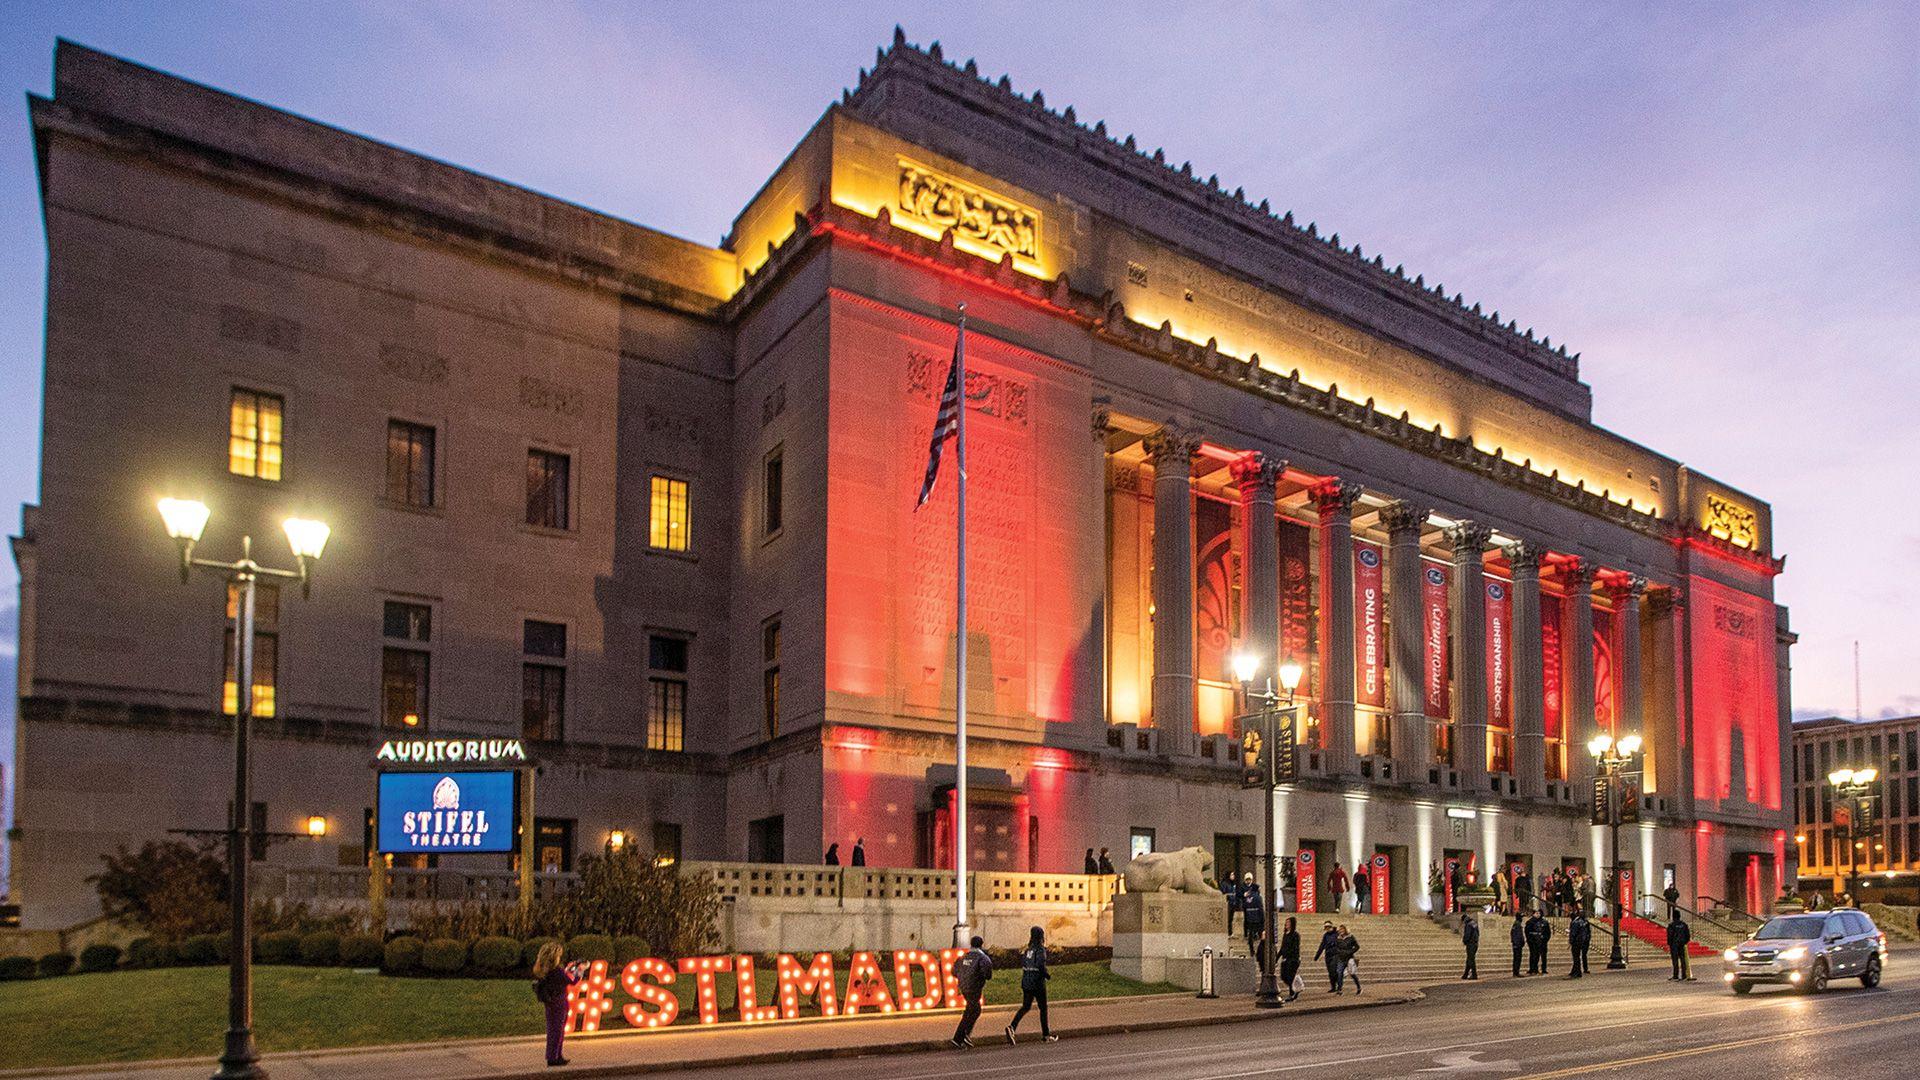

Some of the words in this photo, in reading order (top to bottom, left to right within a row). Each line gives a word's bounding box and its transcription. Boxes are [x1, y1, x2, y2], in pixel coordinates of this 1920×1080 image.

[1365, 588, 1376, 695] CELEBRATING
[1431, 603, 1443, 708] Extraordinary
[1493, 617, 1502, 718] SPORTSMANSHIP
[377, 740, 527, 762] AUDITORIUM
[403, 810, 489, 834] STIFEL
[411, 833, 482, 847] THEATRE
